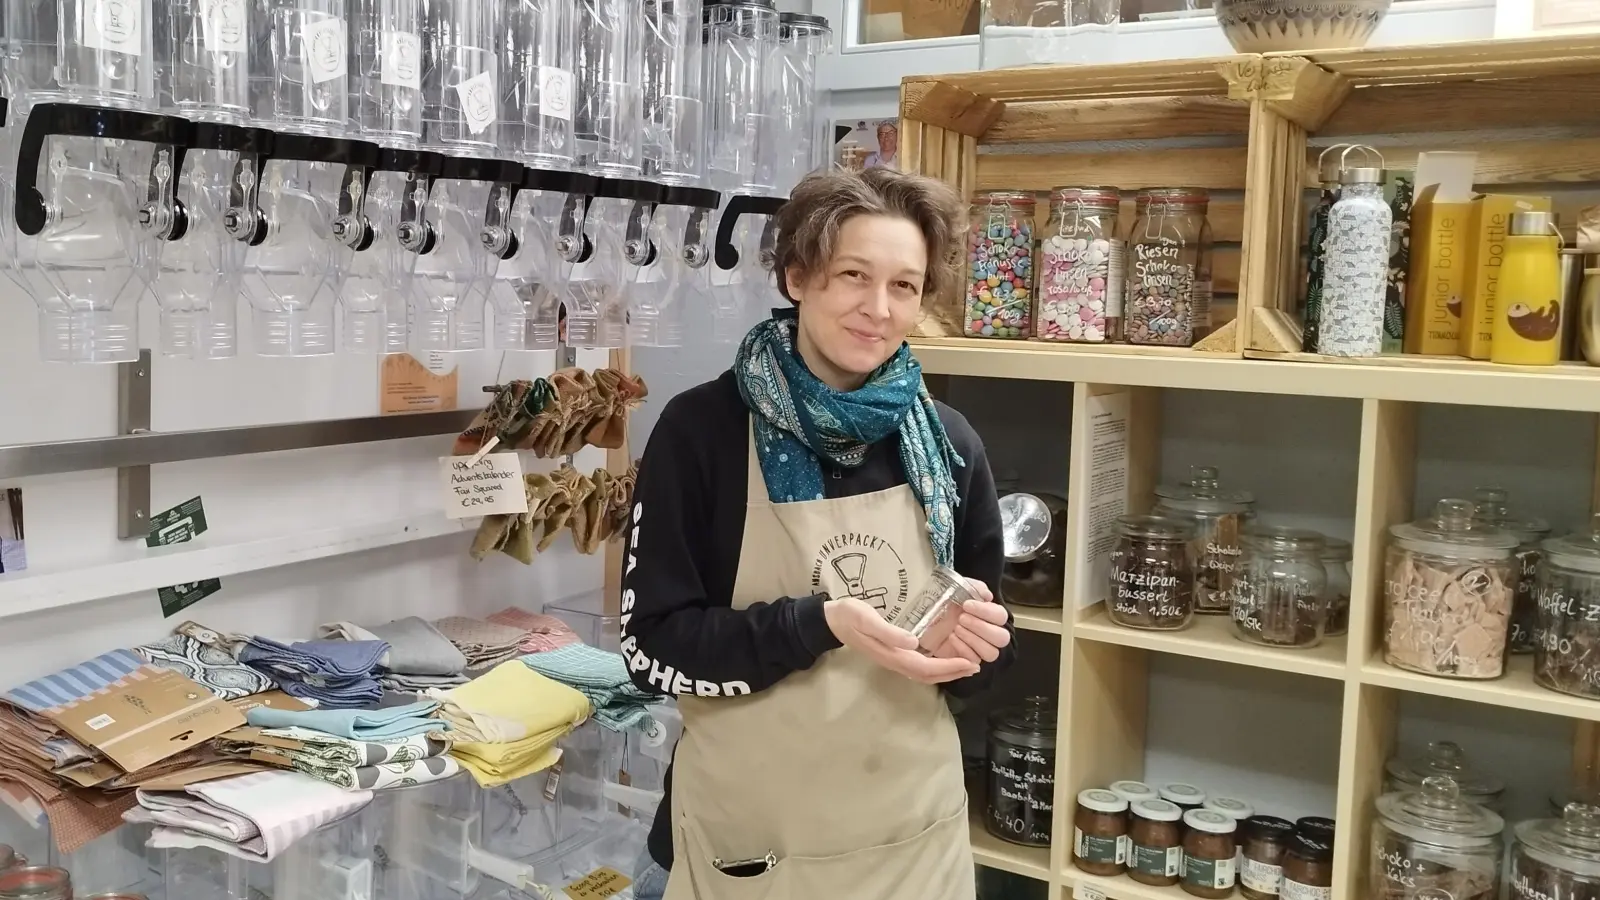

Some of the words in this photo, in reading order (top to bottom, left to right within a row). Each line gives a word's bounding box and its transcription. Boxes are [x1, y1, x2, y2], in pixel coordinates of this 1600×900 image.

[1134, 243, 1179, 261] Riesen
[1433, 217, 1455, 269] bottle
[1484, 213, 1506, 268] bottle
[1428, 276, 1451, 325] junior
[818, 532, 886, 560] UNVERPACKT
